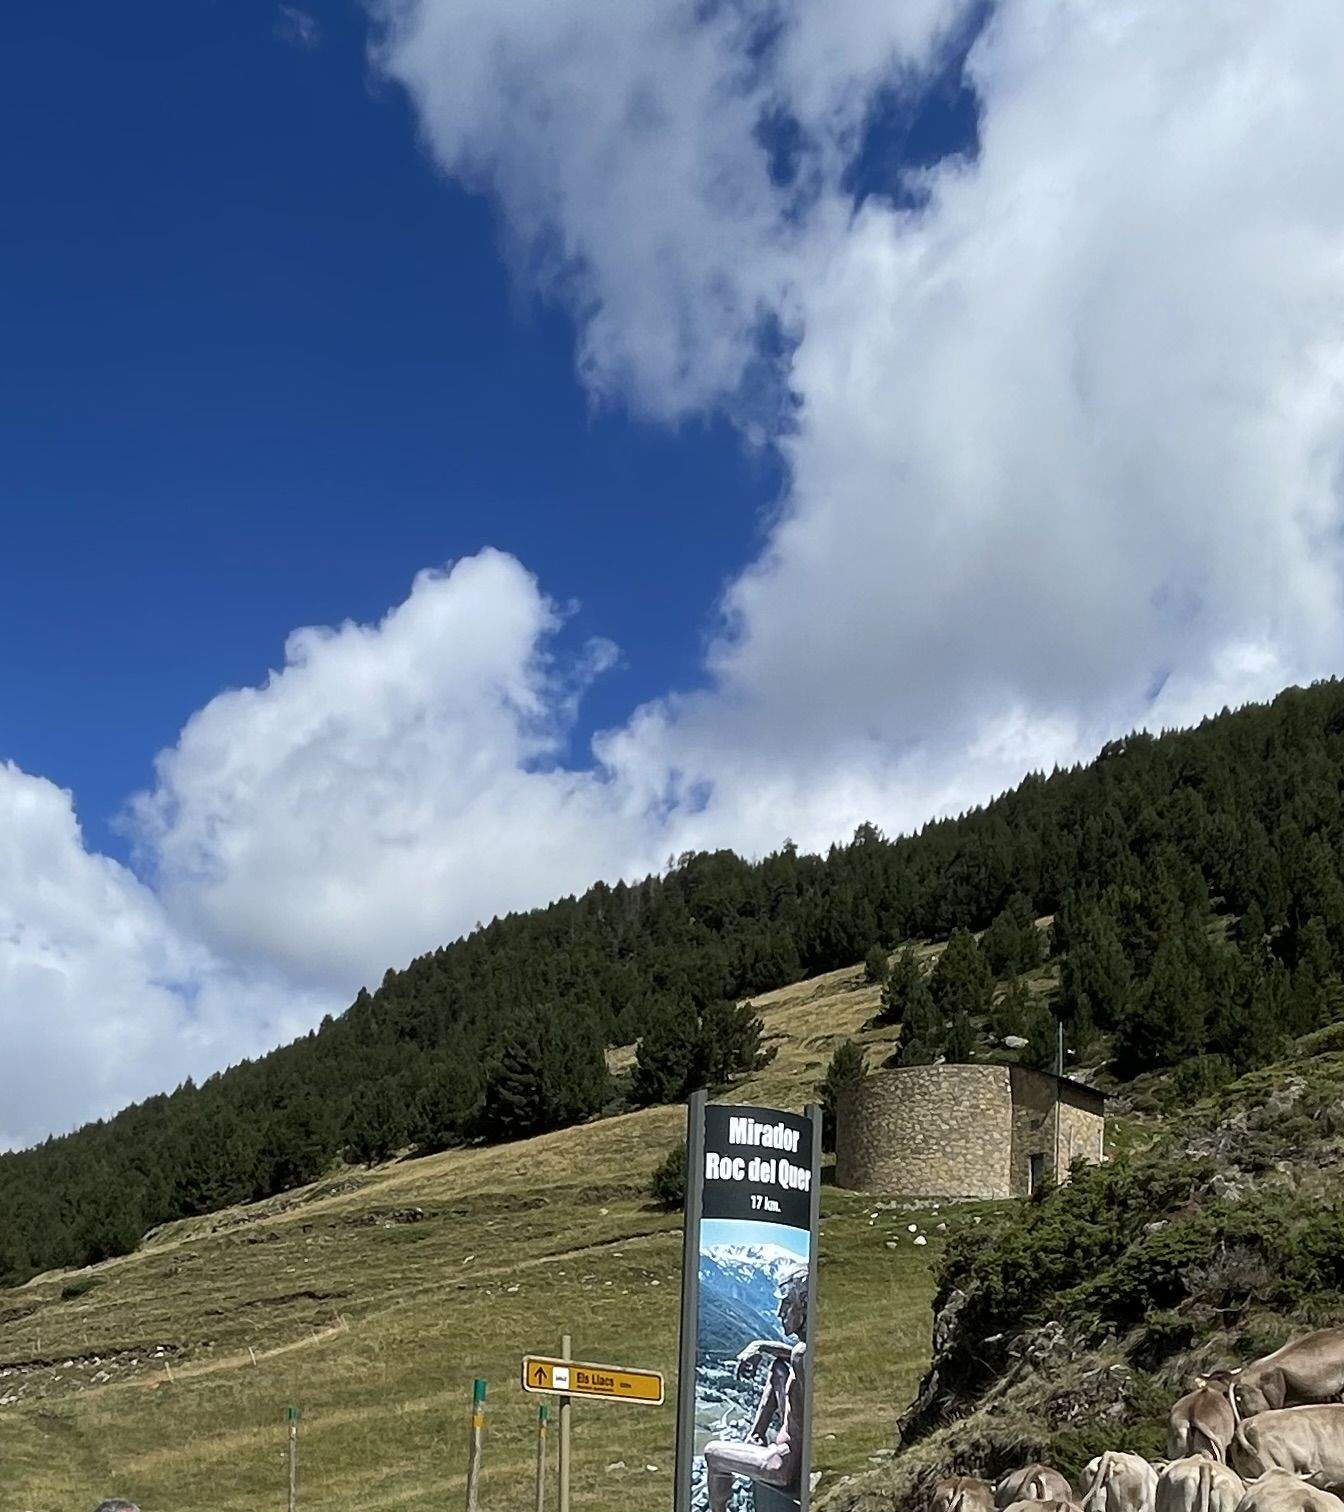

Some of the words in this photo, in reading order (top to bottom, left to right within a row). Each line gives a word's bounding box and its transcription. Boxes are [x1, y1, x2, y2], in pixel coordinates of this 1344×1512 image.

[729, 1116, 800, 1153] Mirador
[705, 1152, 745, 1181] Roc
[748, 1156, 776, 1184] del
[778, 1158, 812, 1192] Quer
[750, 1194, 763, 1210] 17
